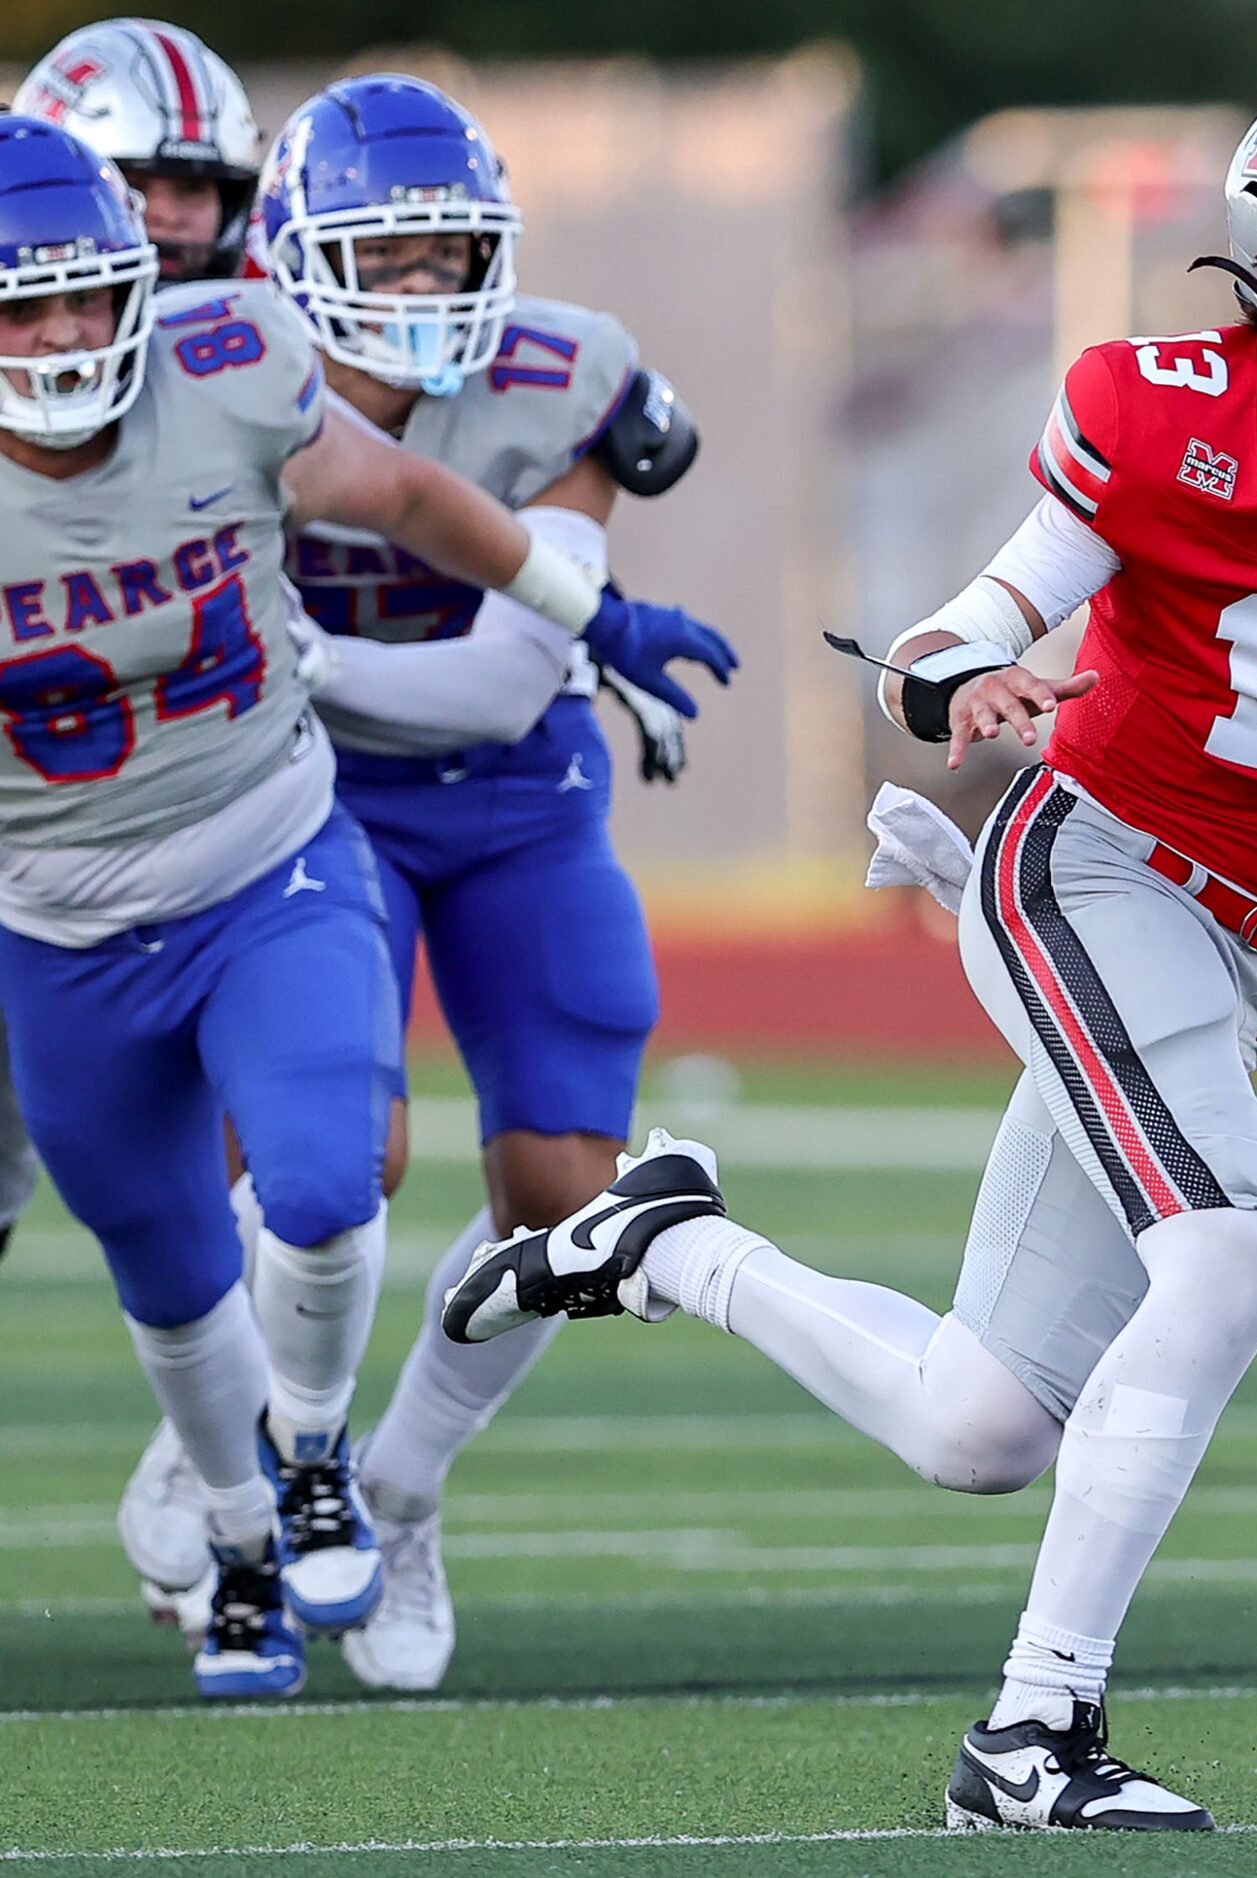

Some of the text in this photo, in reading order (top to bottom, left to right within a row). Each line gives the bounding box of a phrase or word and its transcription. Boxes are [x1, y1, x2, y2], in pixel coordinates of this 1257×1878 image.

[488, 324, 578, 394] 17
[1125, 330, 1229, 398] 13
[1185, 455, 1232, 482] marcus
[0, 520, 251, 645] EARCE
[0, 570, 267, 785] 84
